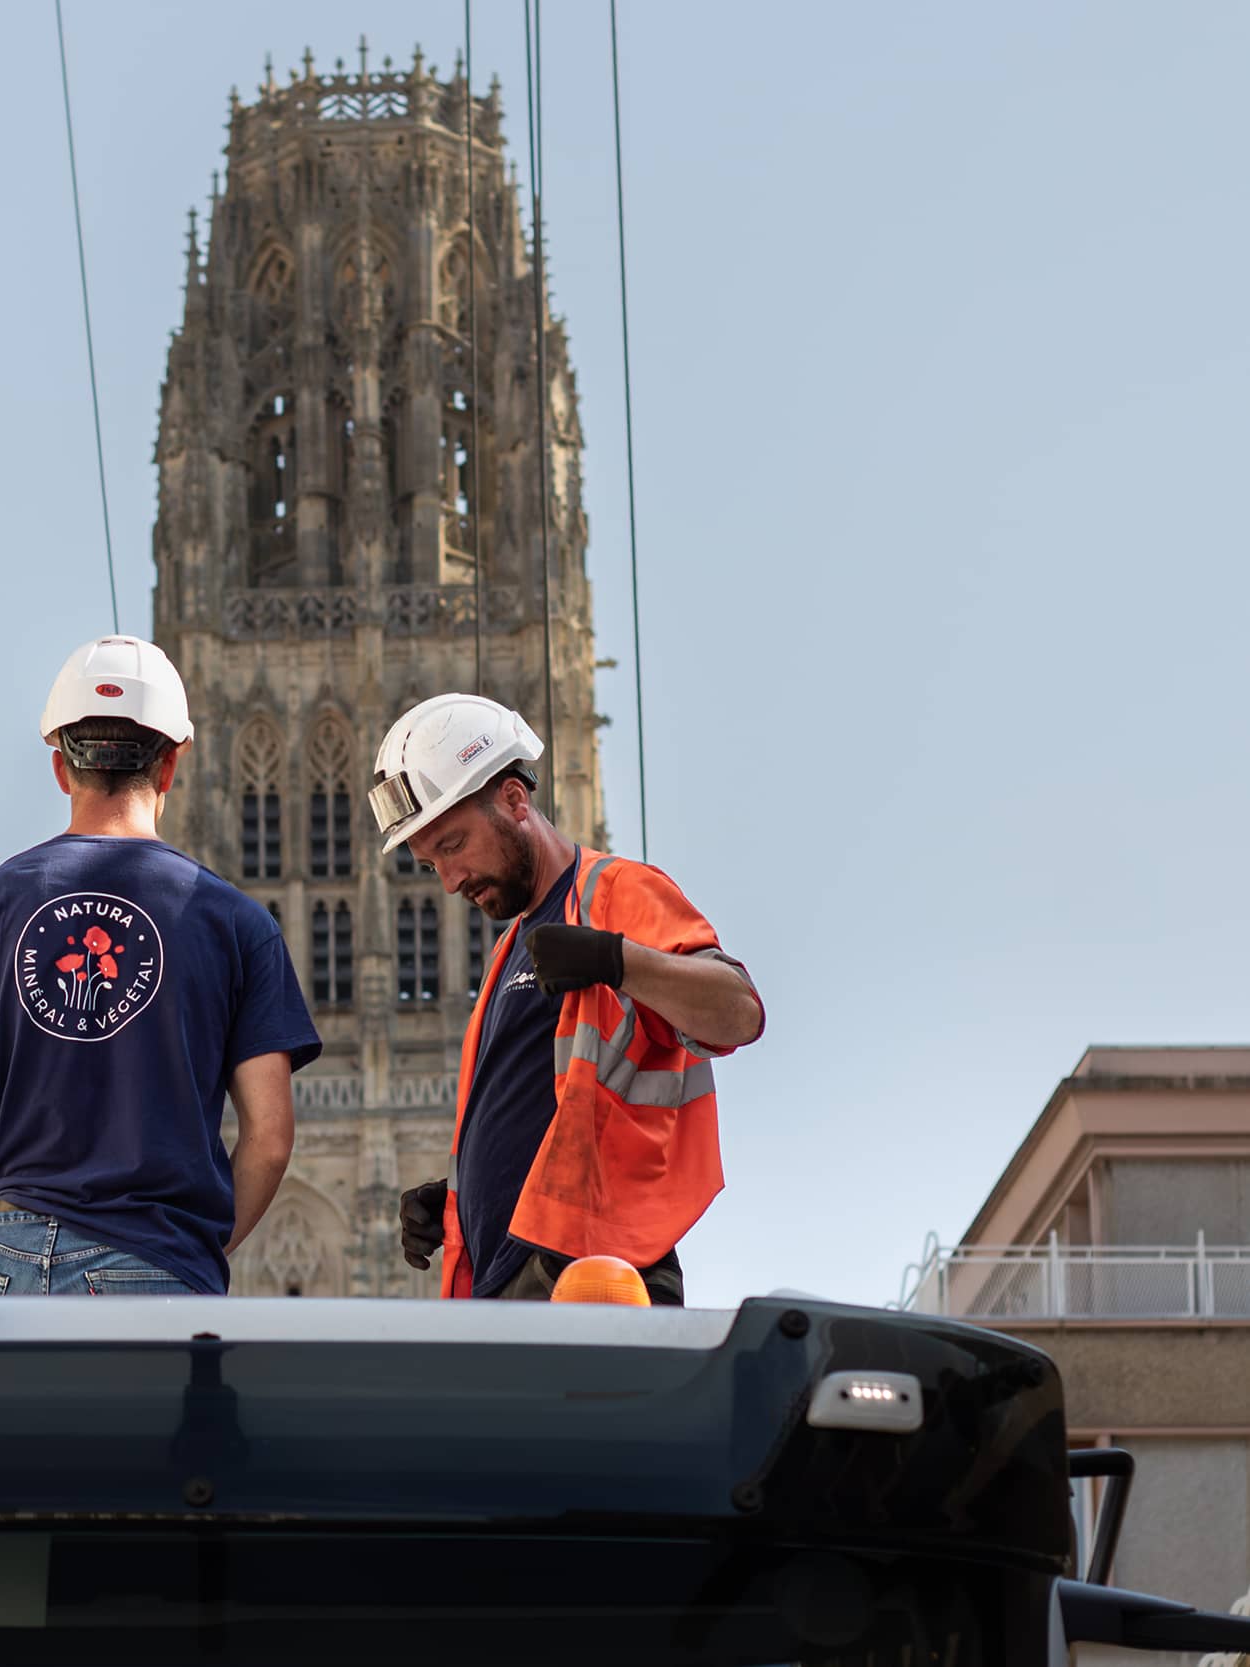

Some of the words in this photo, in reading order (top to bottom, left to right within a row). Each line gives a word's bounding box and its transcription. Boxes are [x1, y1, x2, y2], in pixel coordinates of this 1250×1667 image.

[54, 902, 133, 928] NATURA
[24, 949, 65, 1027] MINÉRAL
[77, 1018, 88, 1031] &
[95, 957, 153, 1029] VÉGÉTAL
